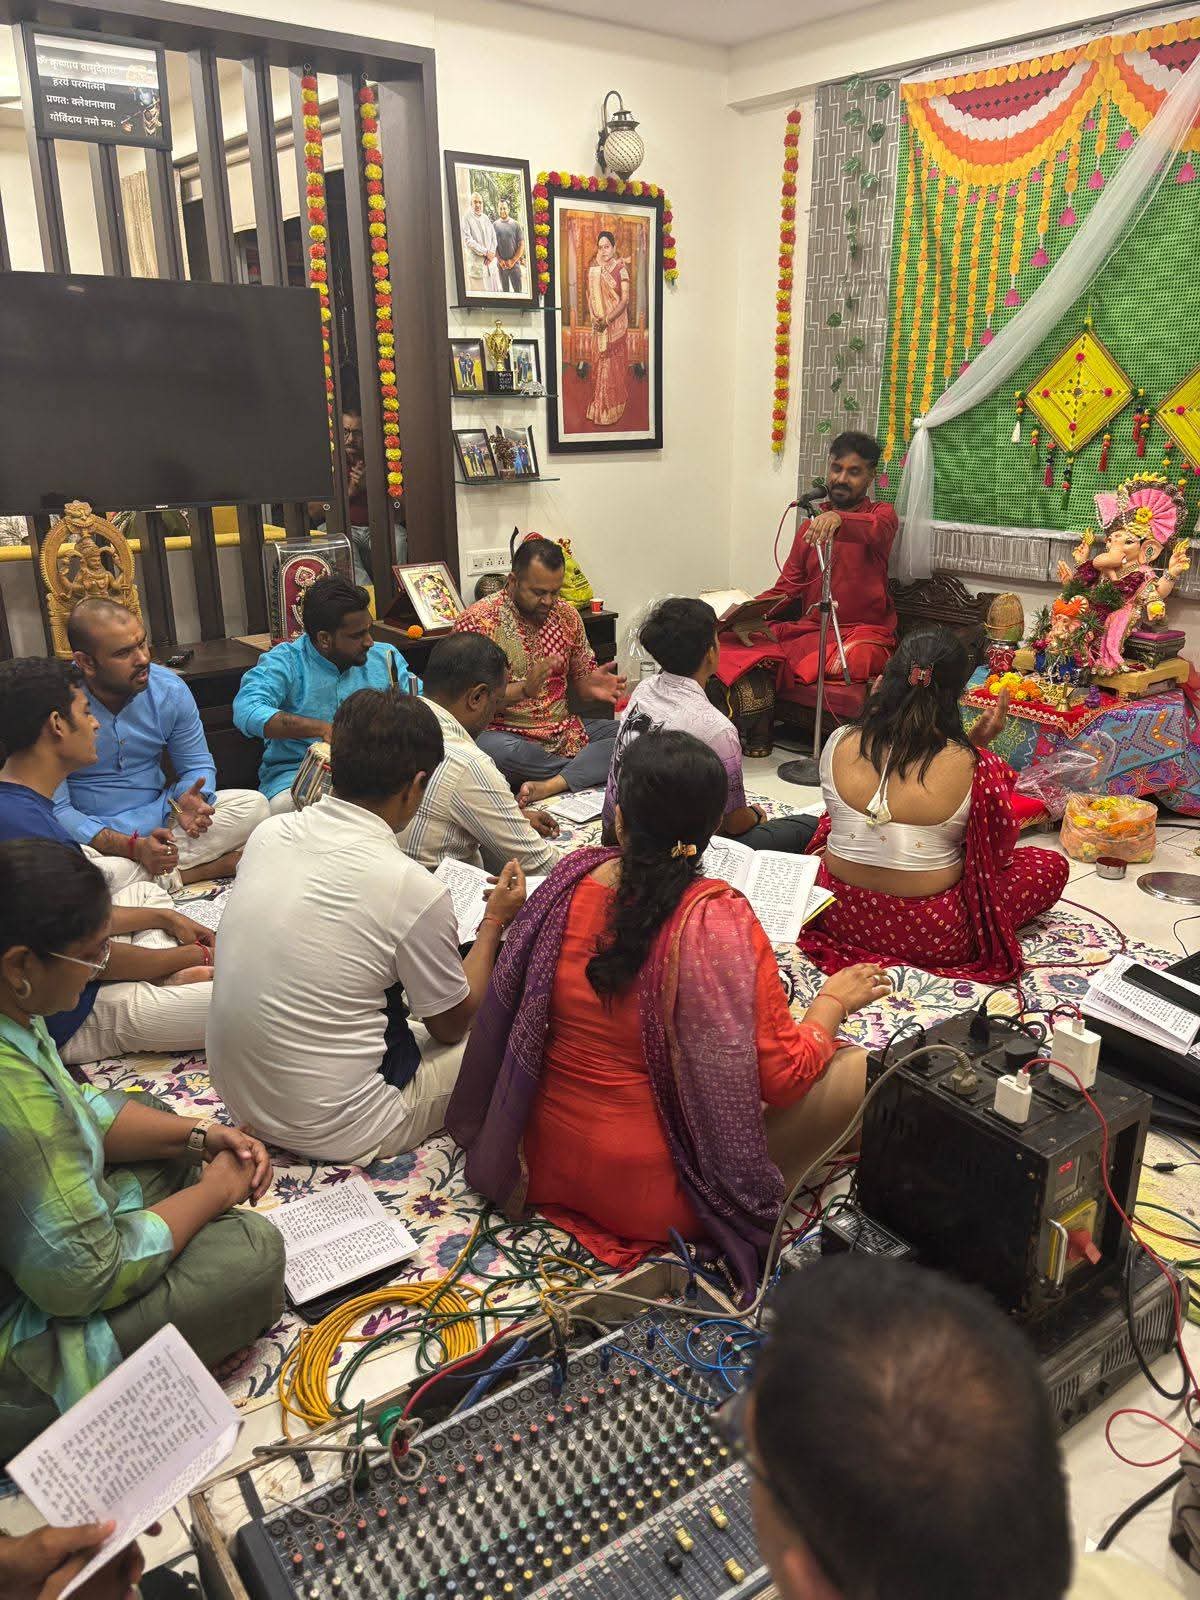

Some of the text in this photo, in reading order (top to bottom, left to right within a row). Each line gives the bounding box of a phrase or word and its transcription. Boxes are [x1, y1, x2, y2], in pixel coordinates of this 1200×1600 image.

[71, 96, 116, 110] क्लेशनाशाय
[84, 115, 99, 126] नमो
[101, 119, 116, 127] नमः
